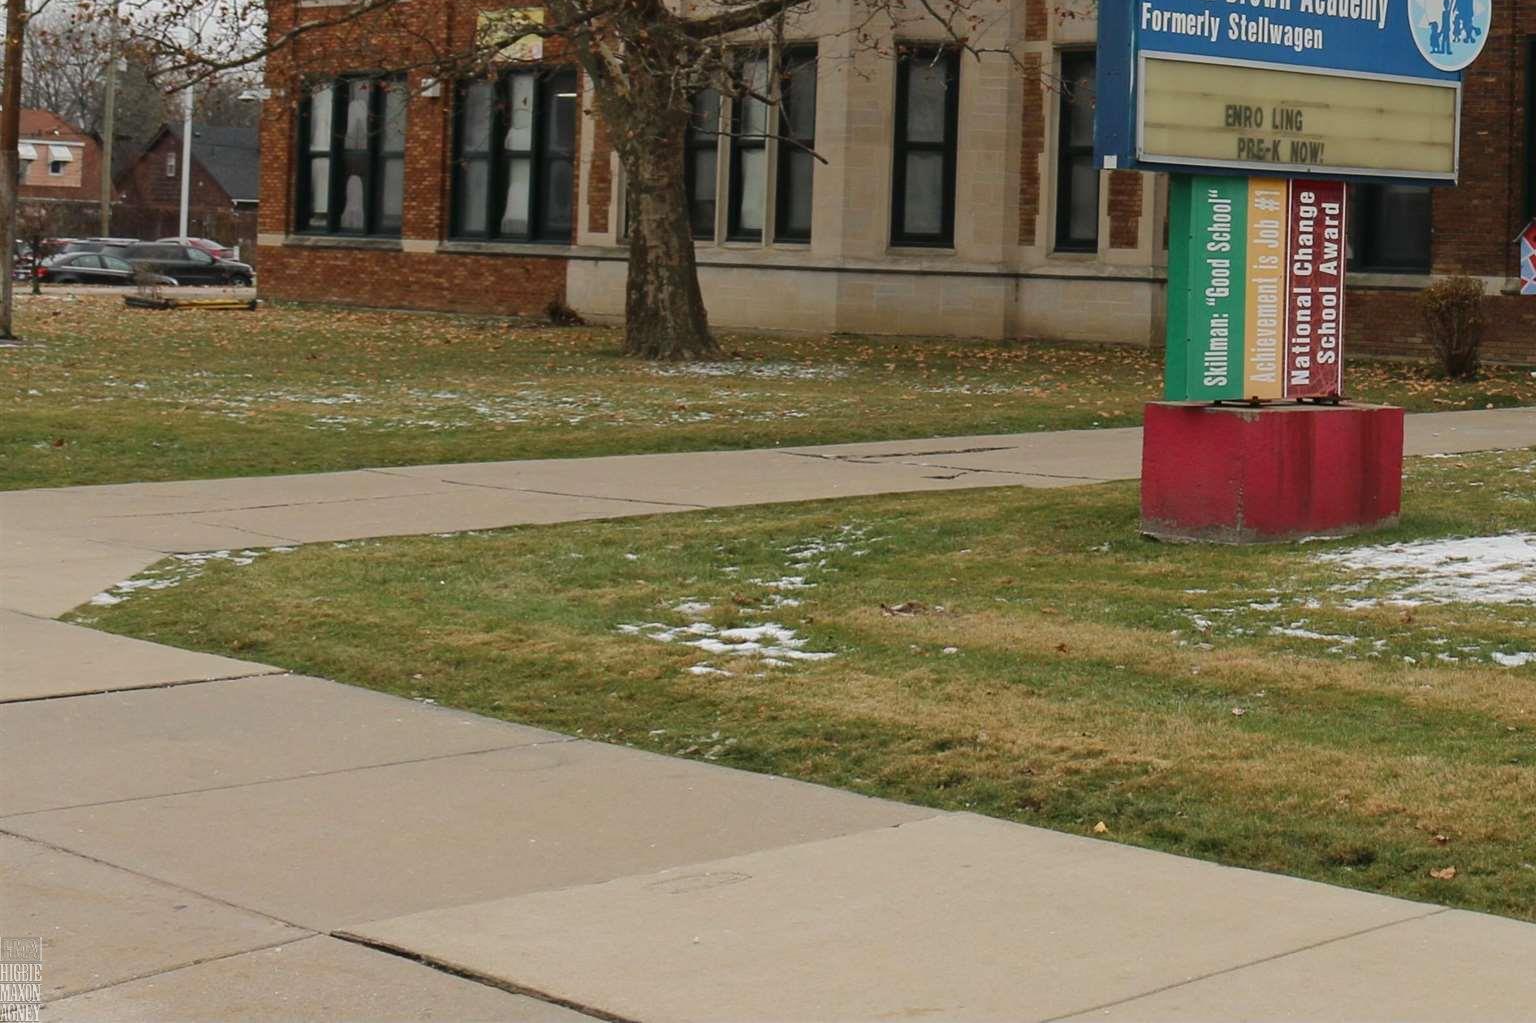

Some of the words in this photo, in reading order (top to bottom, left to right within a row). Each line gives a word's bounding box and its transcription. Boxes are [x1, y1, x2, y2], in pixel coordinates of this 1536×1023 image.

[1141, 2, 1220, 42] Formerly
[1228, 12, 1324, 52] Stellwagen
[1237, 137, 1281, 162] PRE-K
[1290, 141, 1325, 165] NOW!
[1253, 220, 1280, 248] Job
[1254, 190, 1281, 212] #1
[1293, 191, 1318, 276] Change
[1253, 255, 1279, 270] is
[1319, 202, 1340, 276] Award
[1204, 313, 1229, 386] Skillman:
[1250, 277, 1278, 384] Achievement
[1291, 287, 1312, 386] National
[1317, 286, 1337, 364] School
